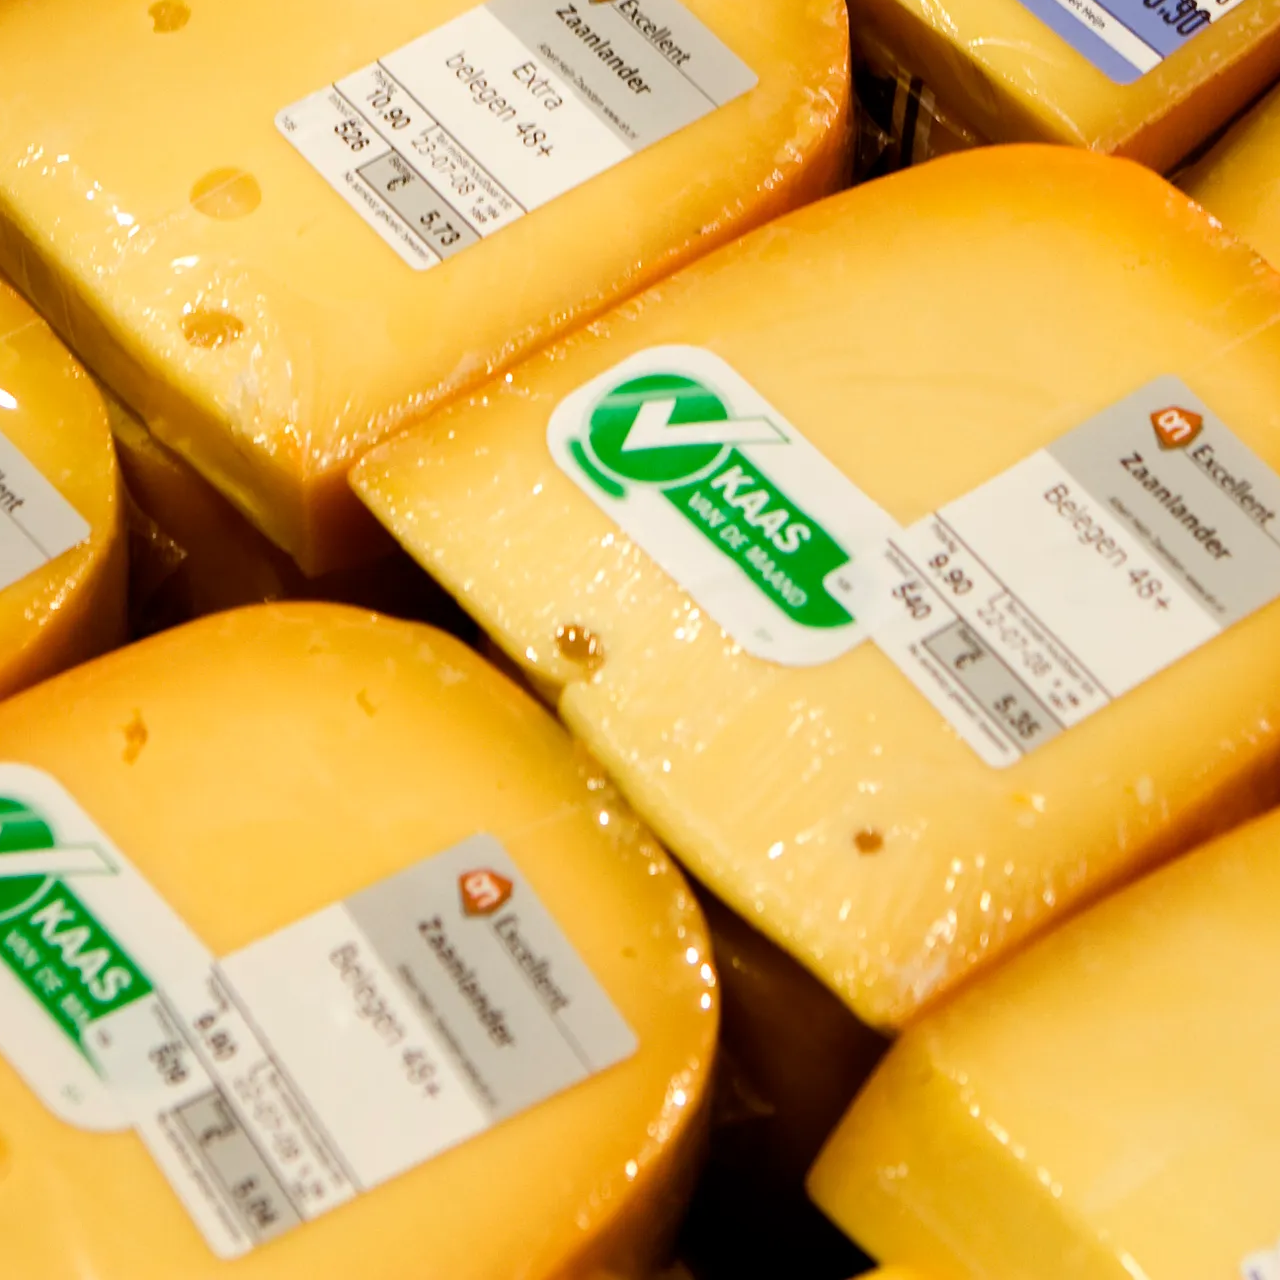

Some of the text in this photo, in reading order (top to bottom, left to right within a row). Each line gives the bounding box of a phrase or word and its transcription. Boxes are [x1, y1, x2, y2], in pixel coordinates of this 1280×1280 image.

[510, 62, 568, 110] Extra
[553, 5, 655, 96] Zaanlander
[438, 52, 561, 160] belegen 48+
[331, 120, 371, 152] 526
[415, 209, 462, 247] 5,73
[408, 134, 477, 196] 23-07-08
[710, 461, 812, 557] KAAS
[1119, 452, 1235, 561] Zaanlander
[1191, 444, 1278, 524] Excellent
[685, 491, 808, 610] VAN DE MAAND
[1040, 483, 1177, 615] Belegen 48+
[1, 928, 62, 996] VAN DE
[29, 893, 132, 1008] KAAS
[321, 940, 416, 1049] Belegen
[416, 916, 522, 1048] Zaanlander
[491, 913, 574, 1012] Excellent
